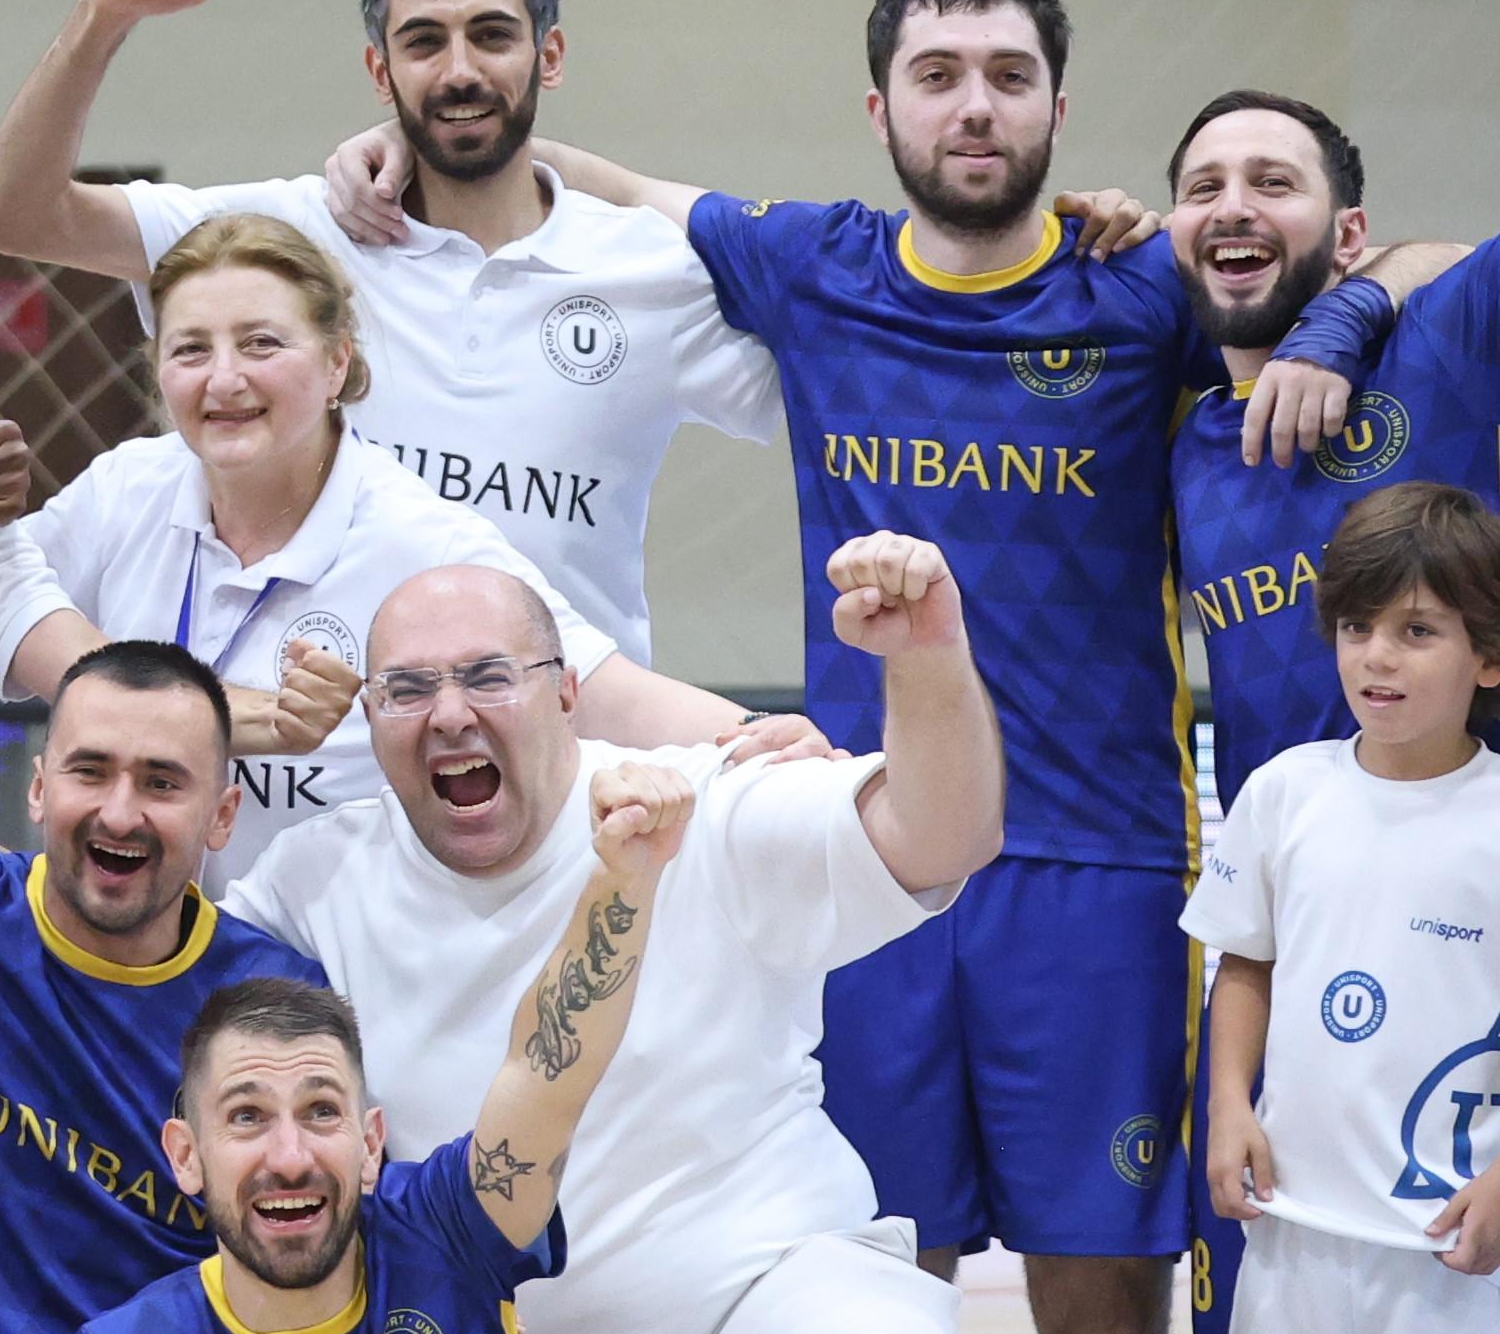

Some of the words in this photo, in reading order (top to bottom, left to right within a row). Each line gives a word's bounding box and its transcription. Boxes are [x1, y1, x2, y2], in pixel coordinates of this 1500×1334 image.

[559, 300, 612, 322] UNISPORT
[573, 325, 596, 354] U
[1344, 420, 1373, 452] U
[825, 434, 1096, 498] UNIBANK
[368, 440, 600, 527] IBANK
[1192, 545, 1328, 635] NIBA
[1409, 917, 1484, 943] unisport
[1343, 994, 1363, 1018] U
[1138, 1140, 1154, 1164] U
